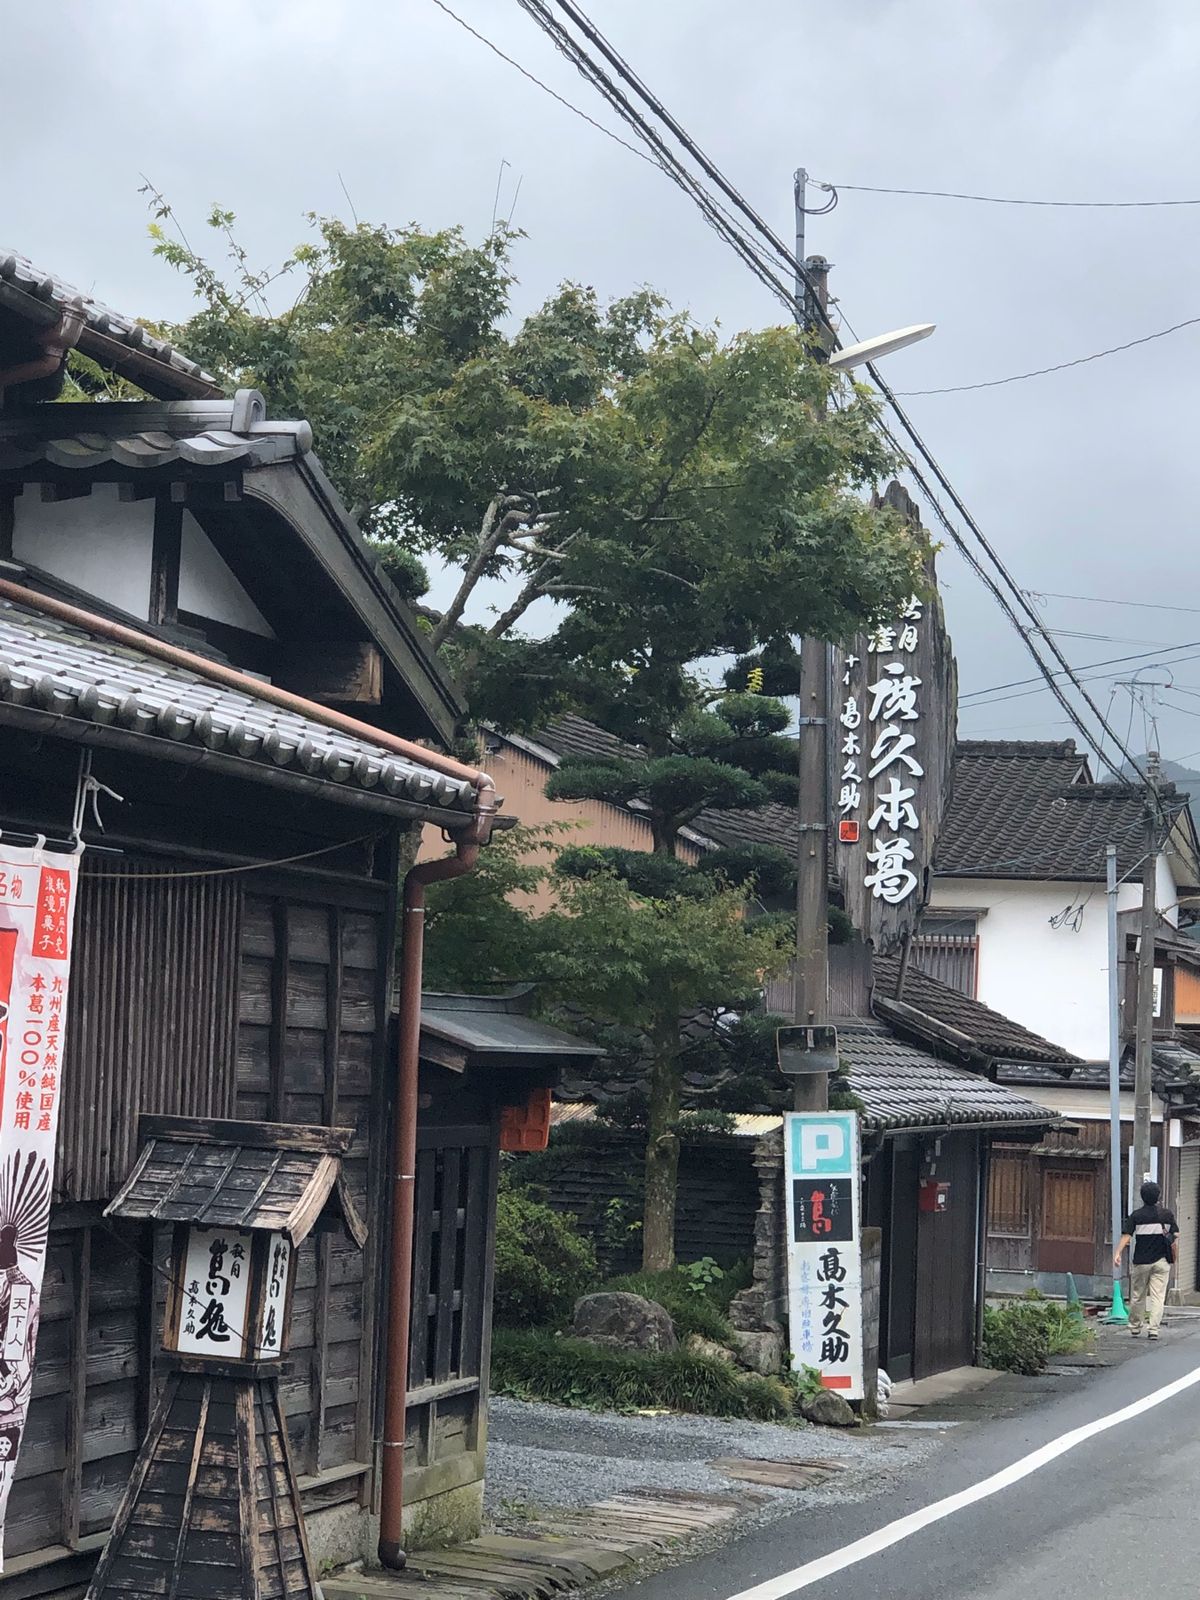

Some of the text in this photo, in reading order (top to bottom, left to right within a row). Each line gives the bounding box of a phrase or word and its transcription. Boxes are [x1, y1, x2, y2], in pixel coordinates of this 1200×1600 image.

[39, 875, 56, 951] 浪漫菓子
[36, 976, 63, 1131] 九州産天然純国産
[801, 1124, 844, 1170] P
[8, 1298, 26, 1346] 天下人
